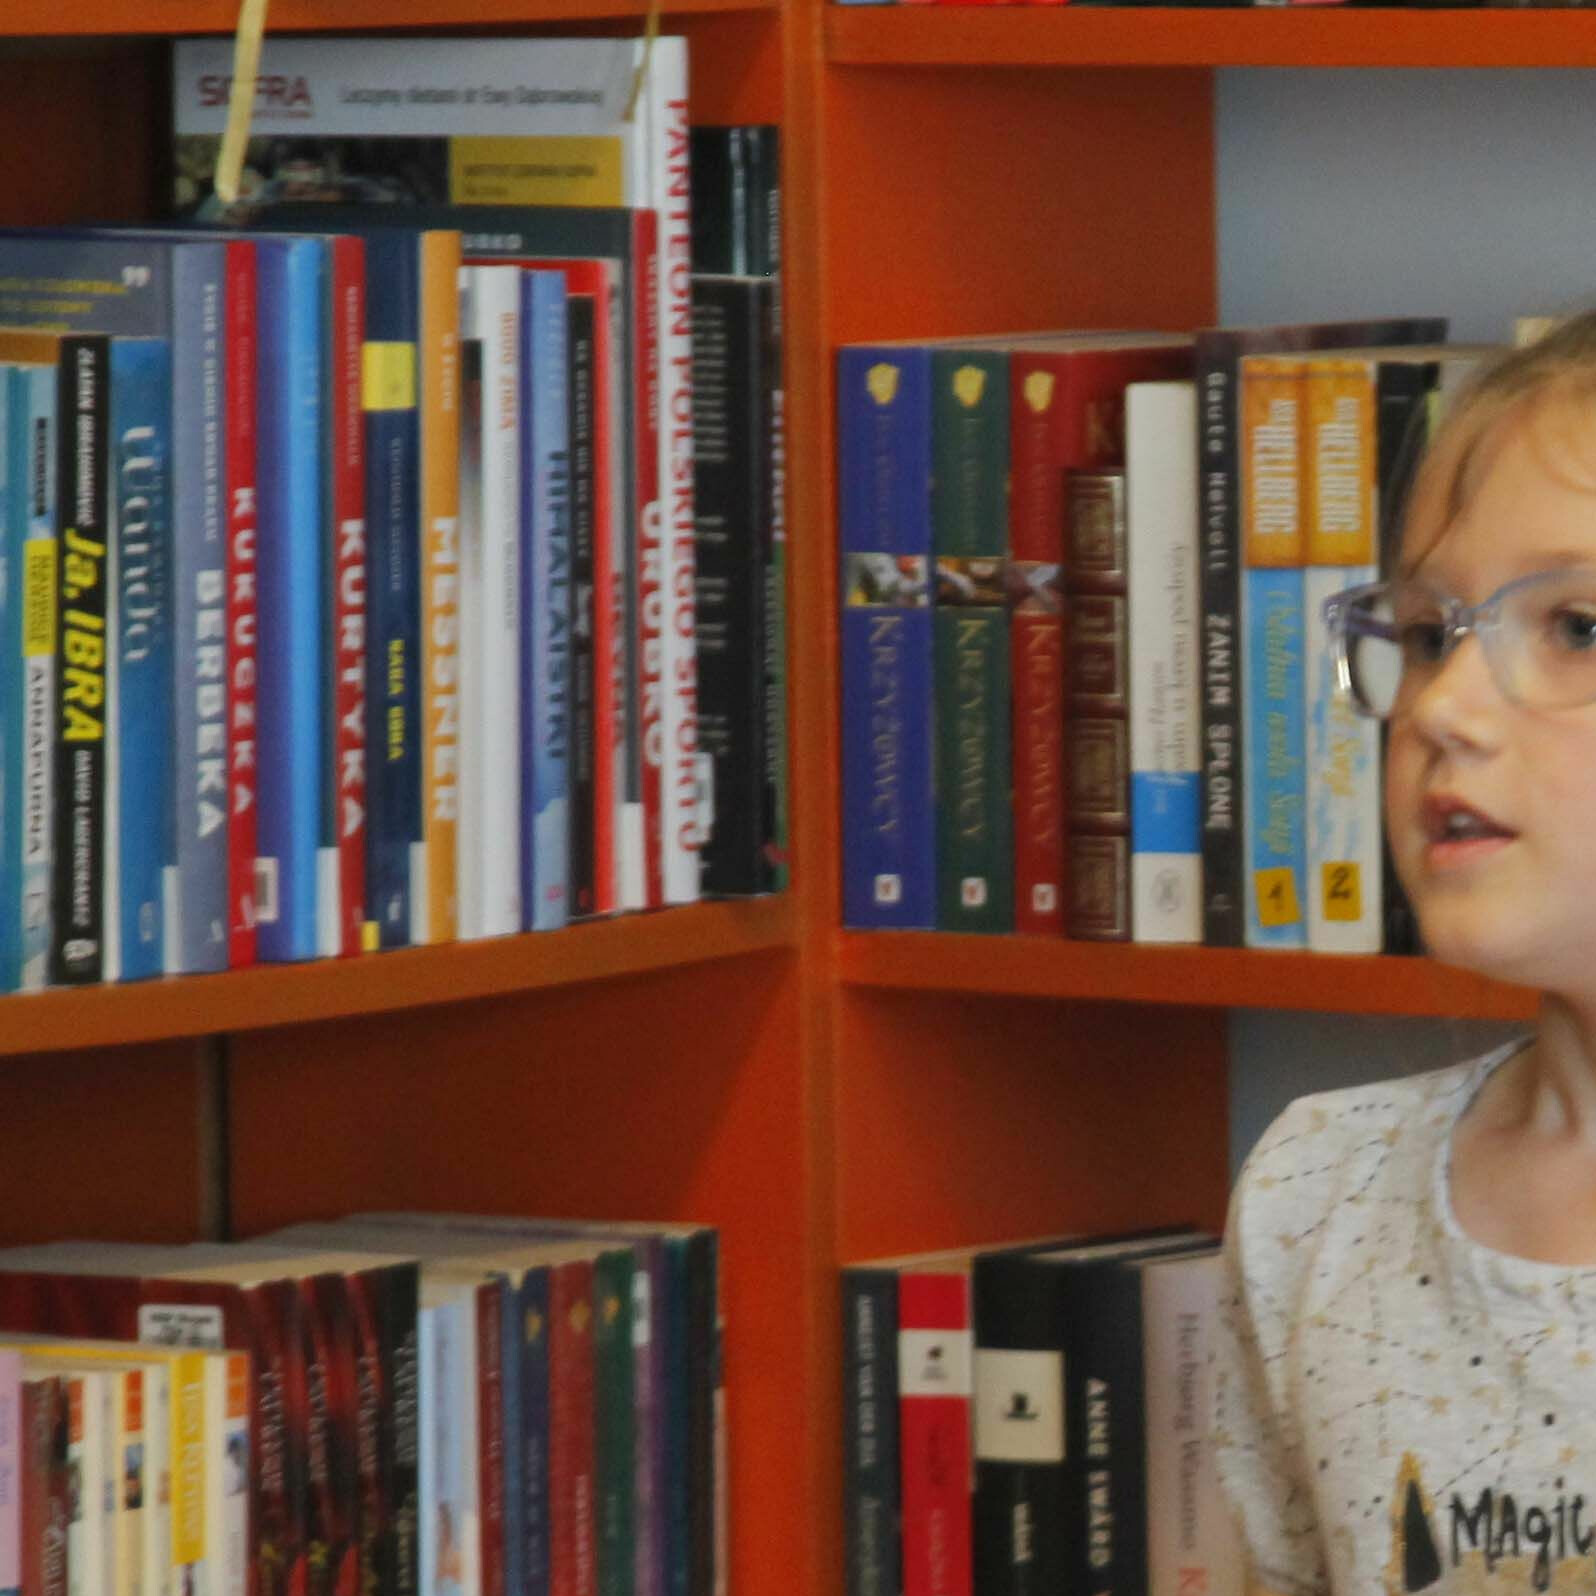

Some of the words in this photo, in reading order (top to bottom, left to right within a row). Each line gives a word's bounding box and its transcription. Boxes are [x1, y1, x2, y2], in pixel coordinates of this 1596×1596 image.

[665, 100, 693, 337] PANTEON
[669, 357, 696, 637] POLSKIEGO
[1251, 424, 1298, 534] HELLBERG
[1316, 422, 1360, 533] HELLBERG
[62, 609, 104, 742] IBRA
[194, 568, 225, 839] BERBEKA
[233, 486, 255, 815] KUKUCZKA
[340, 518, 364, 838] KURTYKA
[430, 515, 458, 822] MESSNER
[548, 452, 568, 760] HIMALAISTKI
[639, 500, 666, 768] URUBKO
[1204, 613, 1231, 708] ZANIM
[27, 667, 45, 856] ANNAPURNA
[673, 657, 699, 852] SPORTU
[1327, 864, 1355, 901] 2
[1086, 1377, 1112, 1457] ANNE
